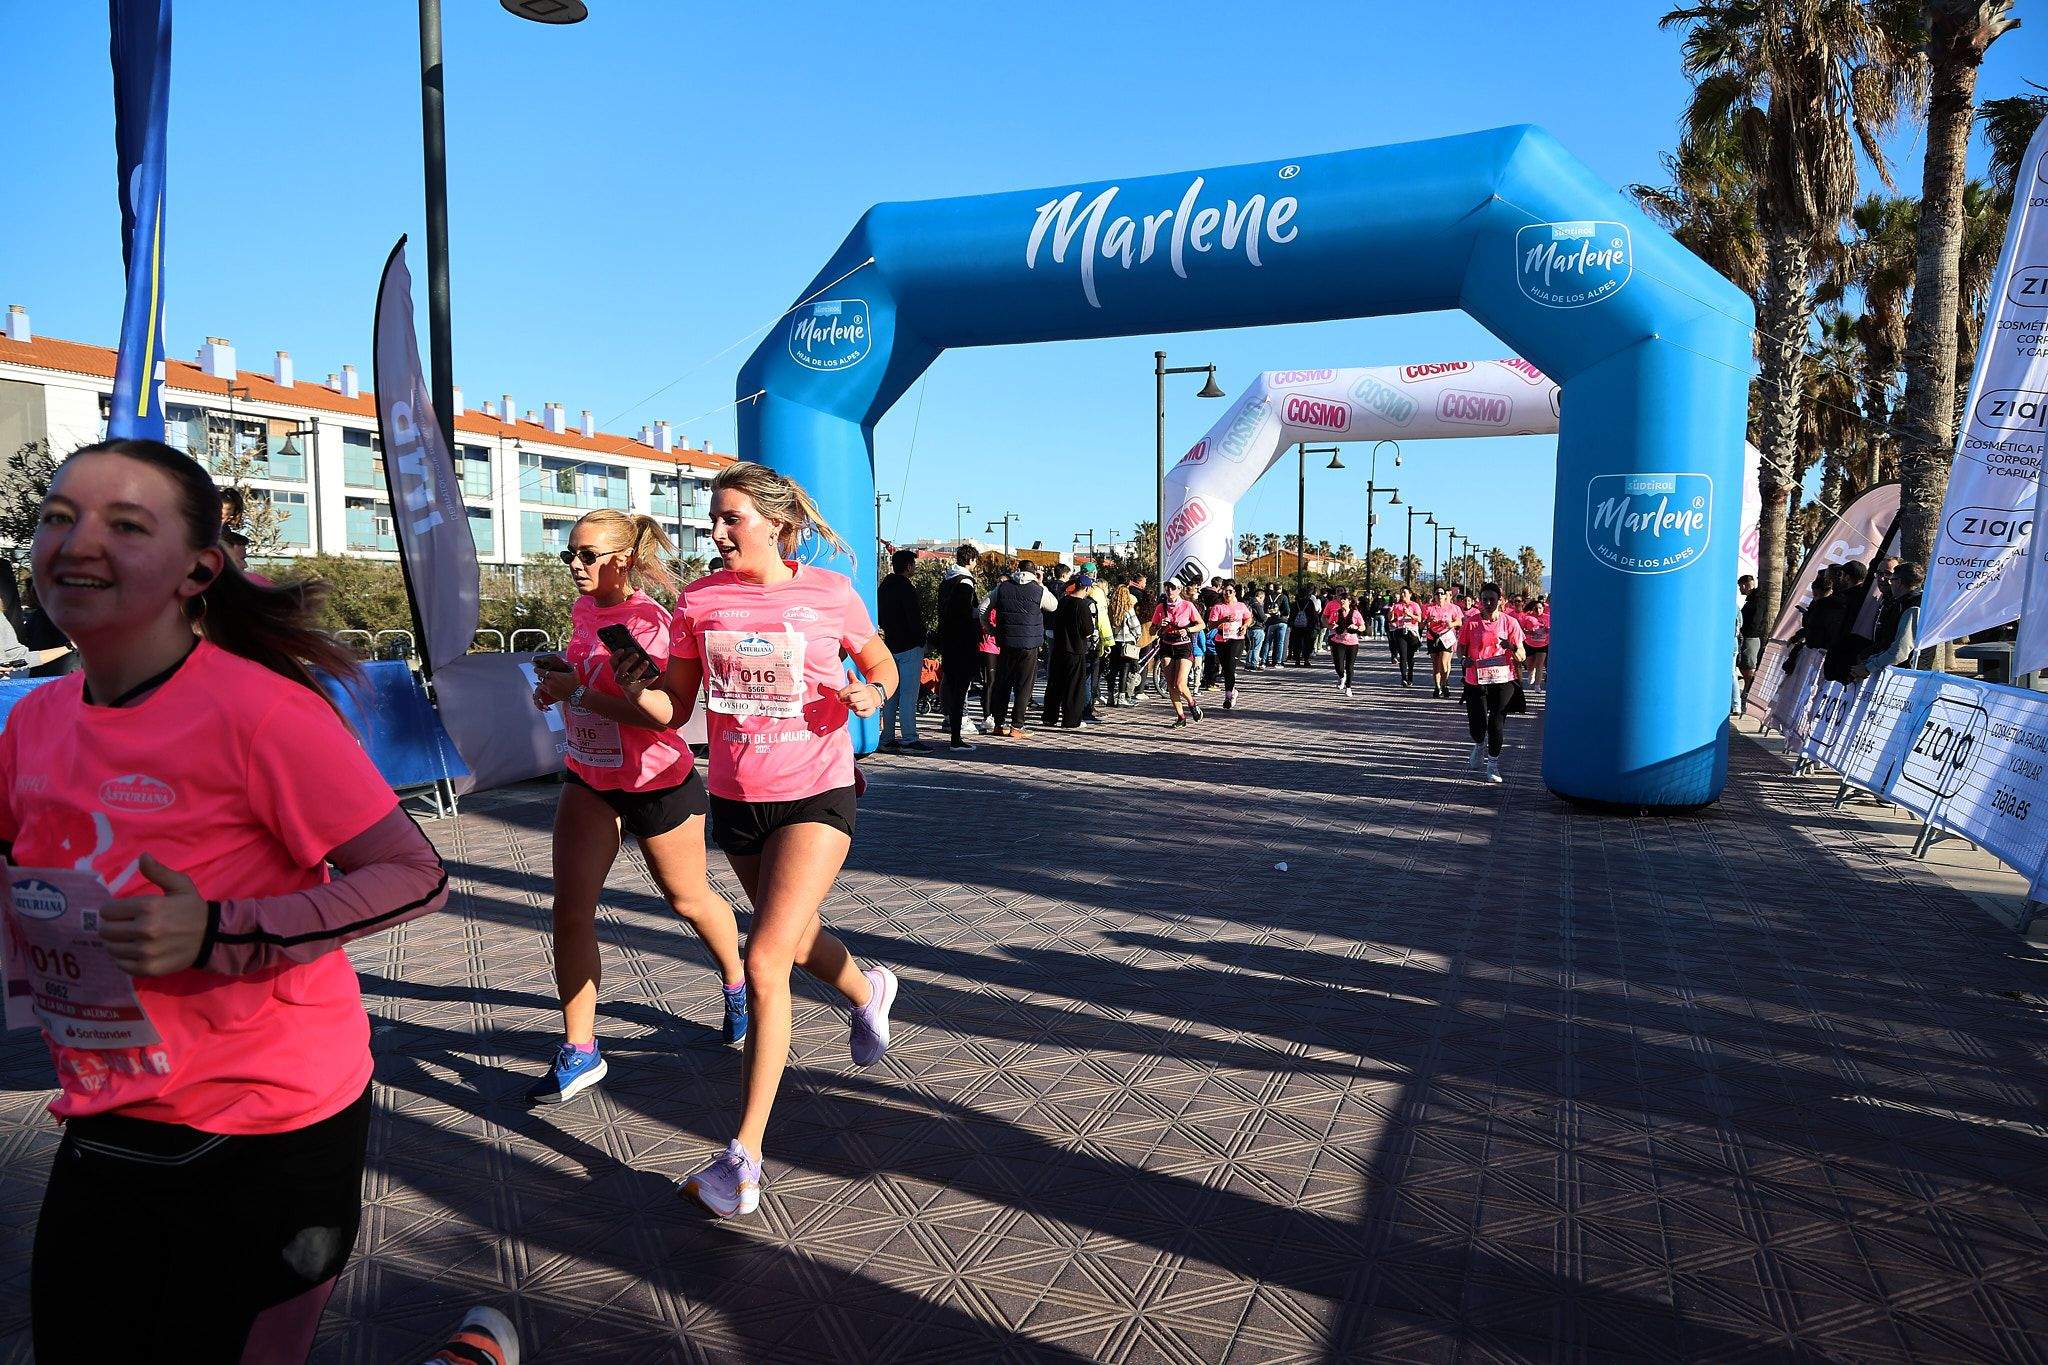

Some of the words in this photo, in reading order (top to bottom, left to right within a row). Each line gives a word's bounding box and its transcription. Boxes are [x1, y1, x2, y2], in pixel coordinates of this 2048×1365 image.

[1025, 176, 1298, 308] Marlene
[1524, 239, 1624, 287] Marlene
[1530, 285, 1549, 301] HIJA
[1551, 294, 1564, 303] DE
[1566, 293, 1585, 303] LOS
[1587, 279, 1617, 299] ALPES
[794, 315, 864, 352] Marlene
[796, 350, 811, 363] HIJA
[812, 358, 822, 366] DE
[823, 359, 838, 367] LOS
[839, 350, 861, 365] ALPES
[2016, 347, 2025, 357] Y
[1405, 361, 1468, 379] COSMO
[1353, 378, 1414, 423] COSMO
[1443, 393, 1506, 423] COSMO
[1287, 397, 1346, 429] COSMO
[1964, 439, 2034, 454] COSMÉTICA
[1987, 466, 1996, 475] Y
[1165, 502, 1207, 551] COSMO
[1594, 495, 1704, 547] Marlene
[1597, 544, 1619, 561] HIJA
[1620, 556, 1635, 567] DE
[1637, 558, 1660, 568] LOS
[1662, 546, 1694, 566] ALPES
[1957, 582, 1965, 591] Y
[740, 669, 776, 683] 016
[719, 701, 749, 710] OYSHO
[754, 733, 766, 744] DE
[768, 732, 778, 744] LA
[780, 729, 811, 742] MUJER
[105, 786, 170, 805] ASTURIANA
[1991, 784, 2031, 820] ziaja.es
[30, 944, 81, 980] 016
[77, 1027, 132, 1040] Santander
